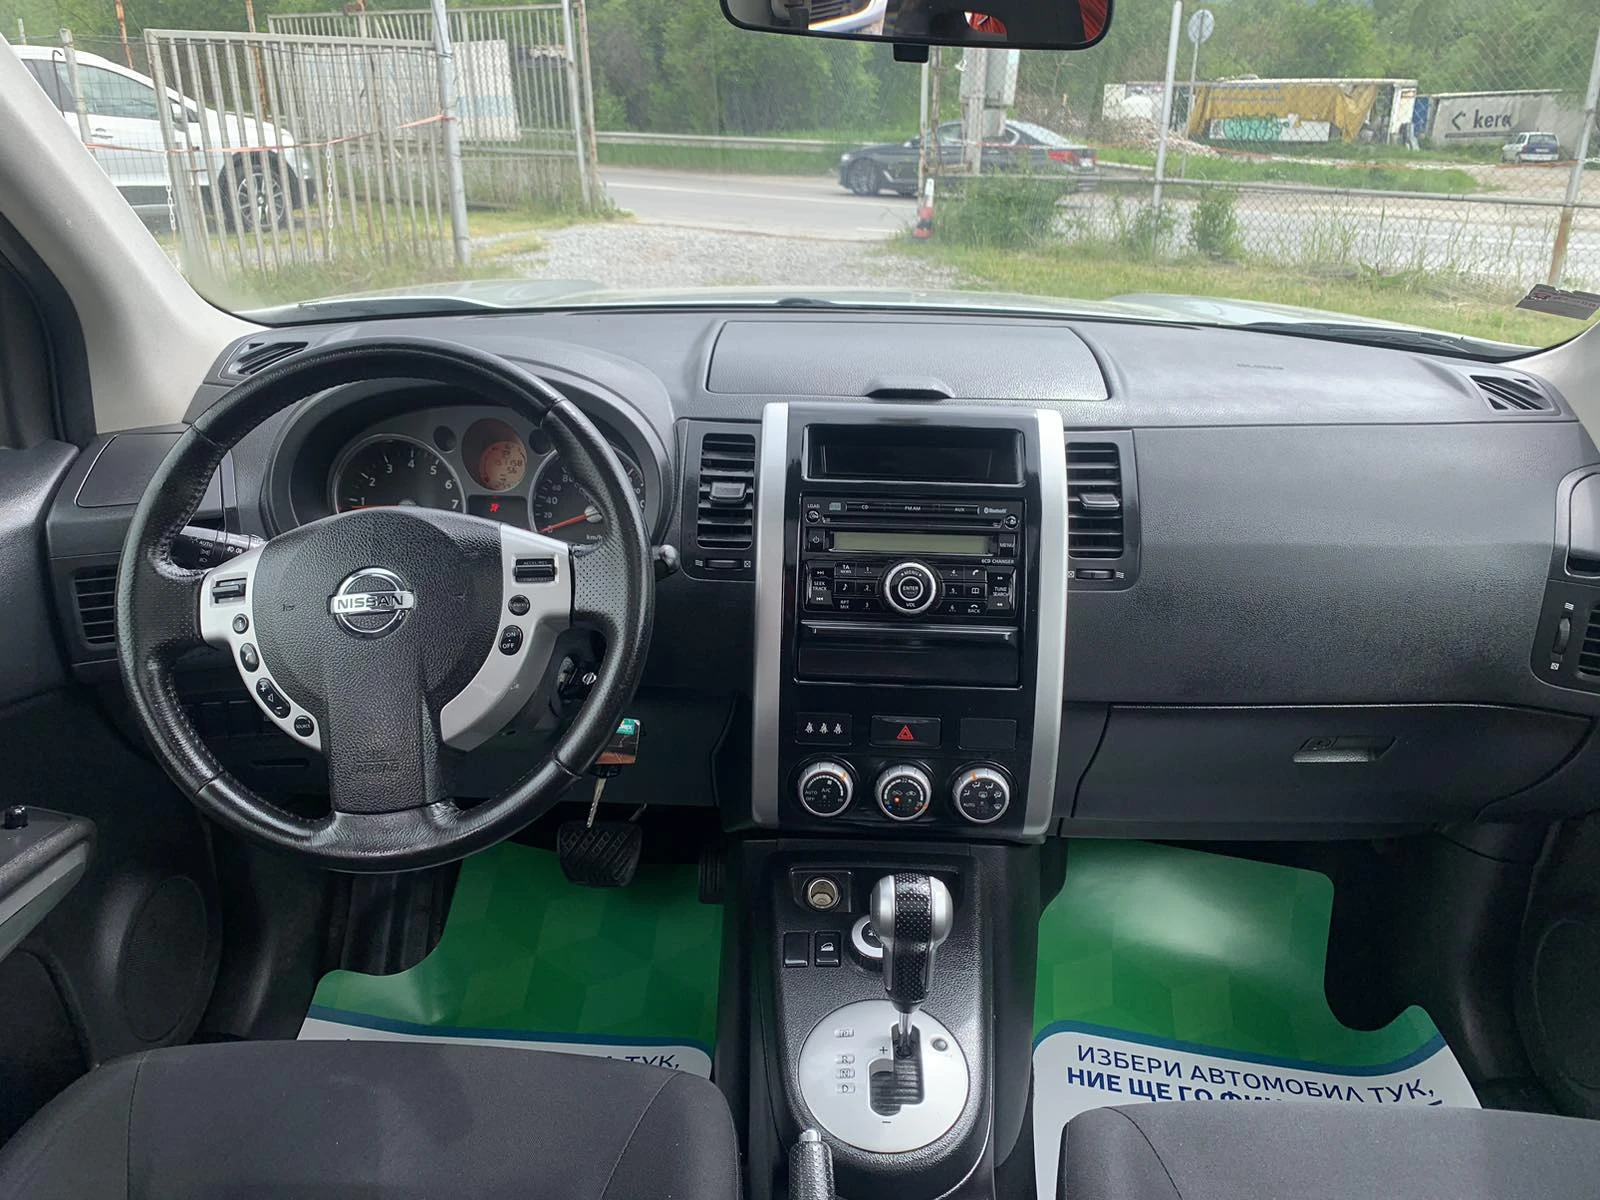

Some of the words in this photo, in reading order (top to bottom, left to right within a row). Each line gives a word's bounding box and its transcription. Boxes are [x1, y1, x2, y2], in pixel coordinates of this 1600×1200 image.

[386, 463, 393, 474] 3
[407, 460, 415, 468] 4
[430, 465, 437, 475] 5
[369, 477, 376, 487] 2
[445, 480, 453, 489] 6
[451, 499, 459, 509] 7
[546, 497, 558, 505] 40
[337, 595, 404, 610] NISSAN
[1077, 1044, 1182, 1079] ИЗБЕРИ
[1190, 1065, 1365, 1103] АВТОМОБИЛ
[1367, 1078, 1435, 1104] ТУК,
[1067, 1067, 1123, 1093] НИЕ
[1128, 1078, 1173, 1102] ЩЕ
